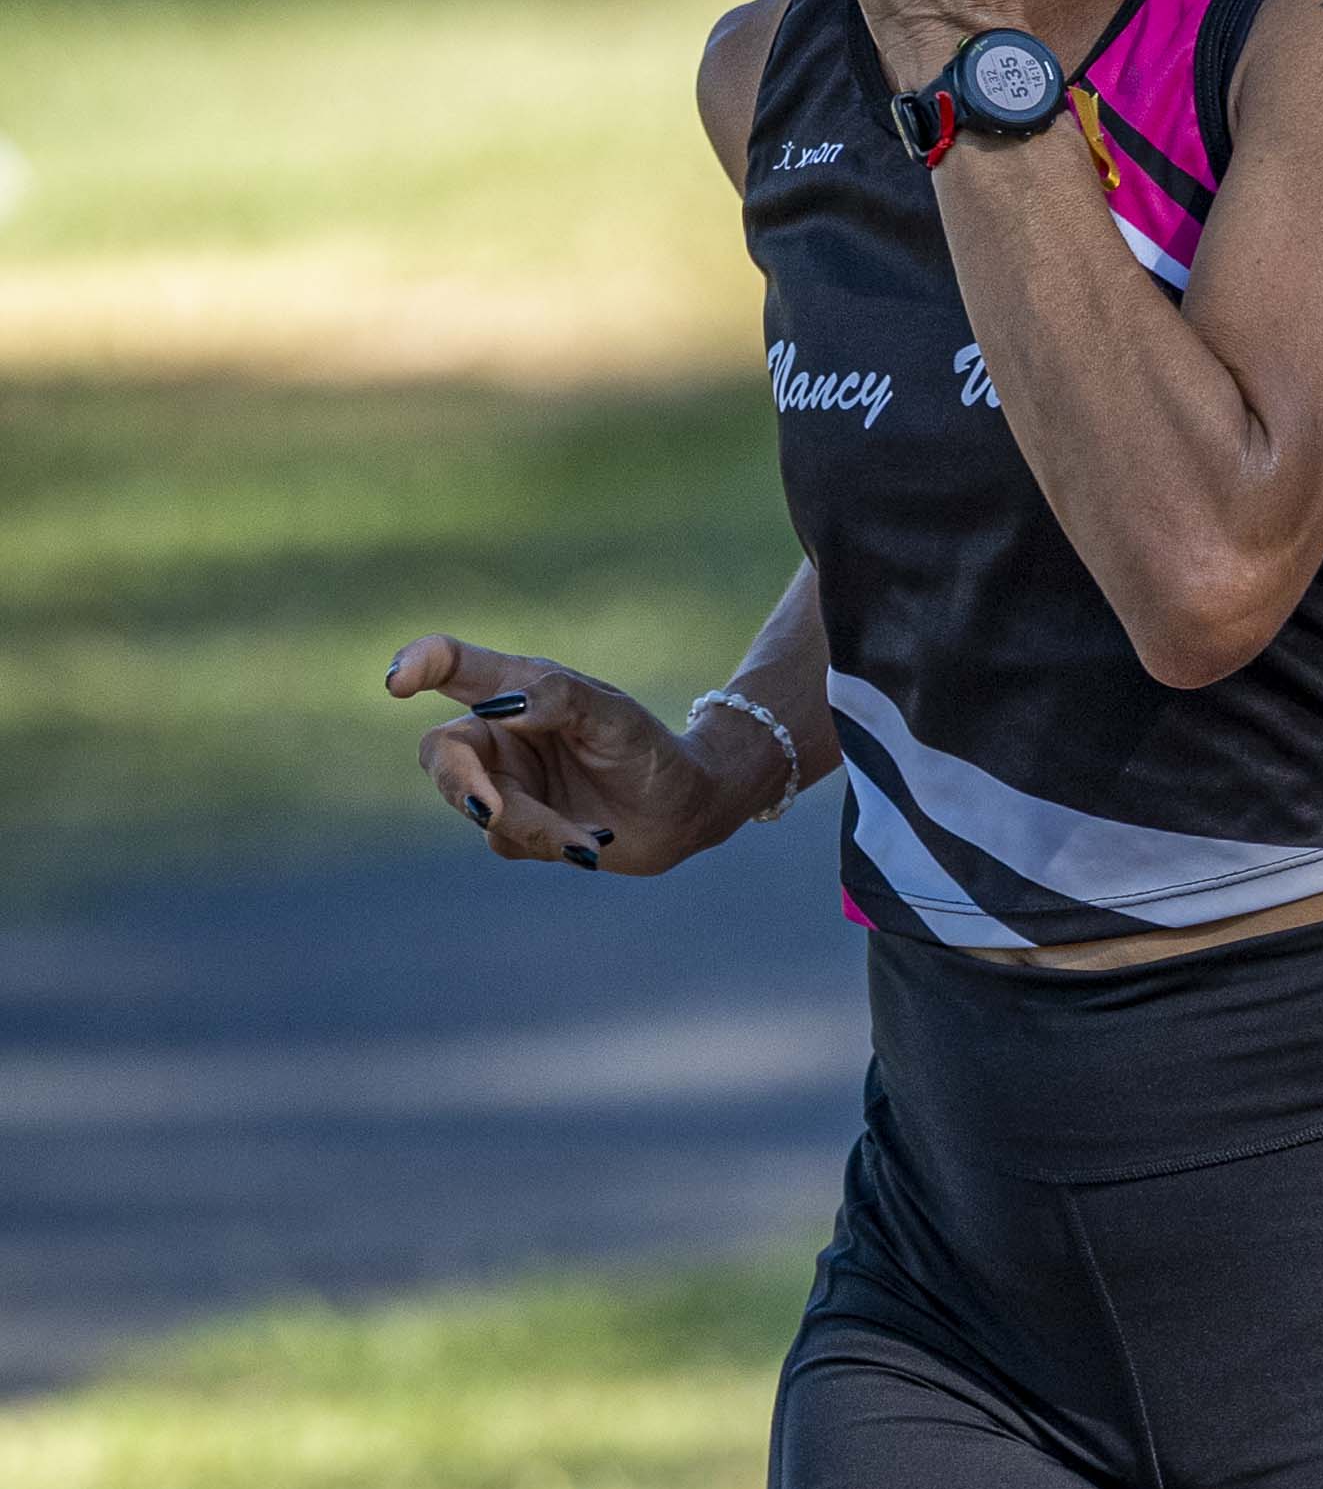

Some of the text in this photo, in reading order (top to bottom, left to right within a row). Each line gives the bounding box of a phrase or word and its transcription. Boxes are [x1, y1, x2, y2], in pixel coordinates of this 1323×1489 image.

[1000, 57, 1029, 98] 5:35
[1025, 58, 1043, 88] 14:18
[767, 339, 893, 429] Nancy
